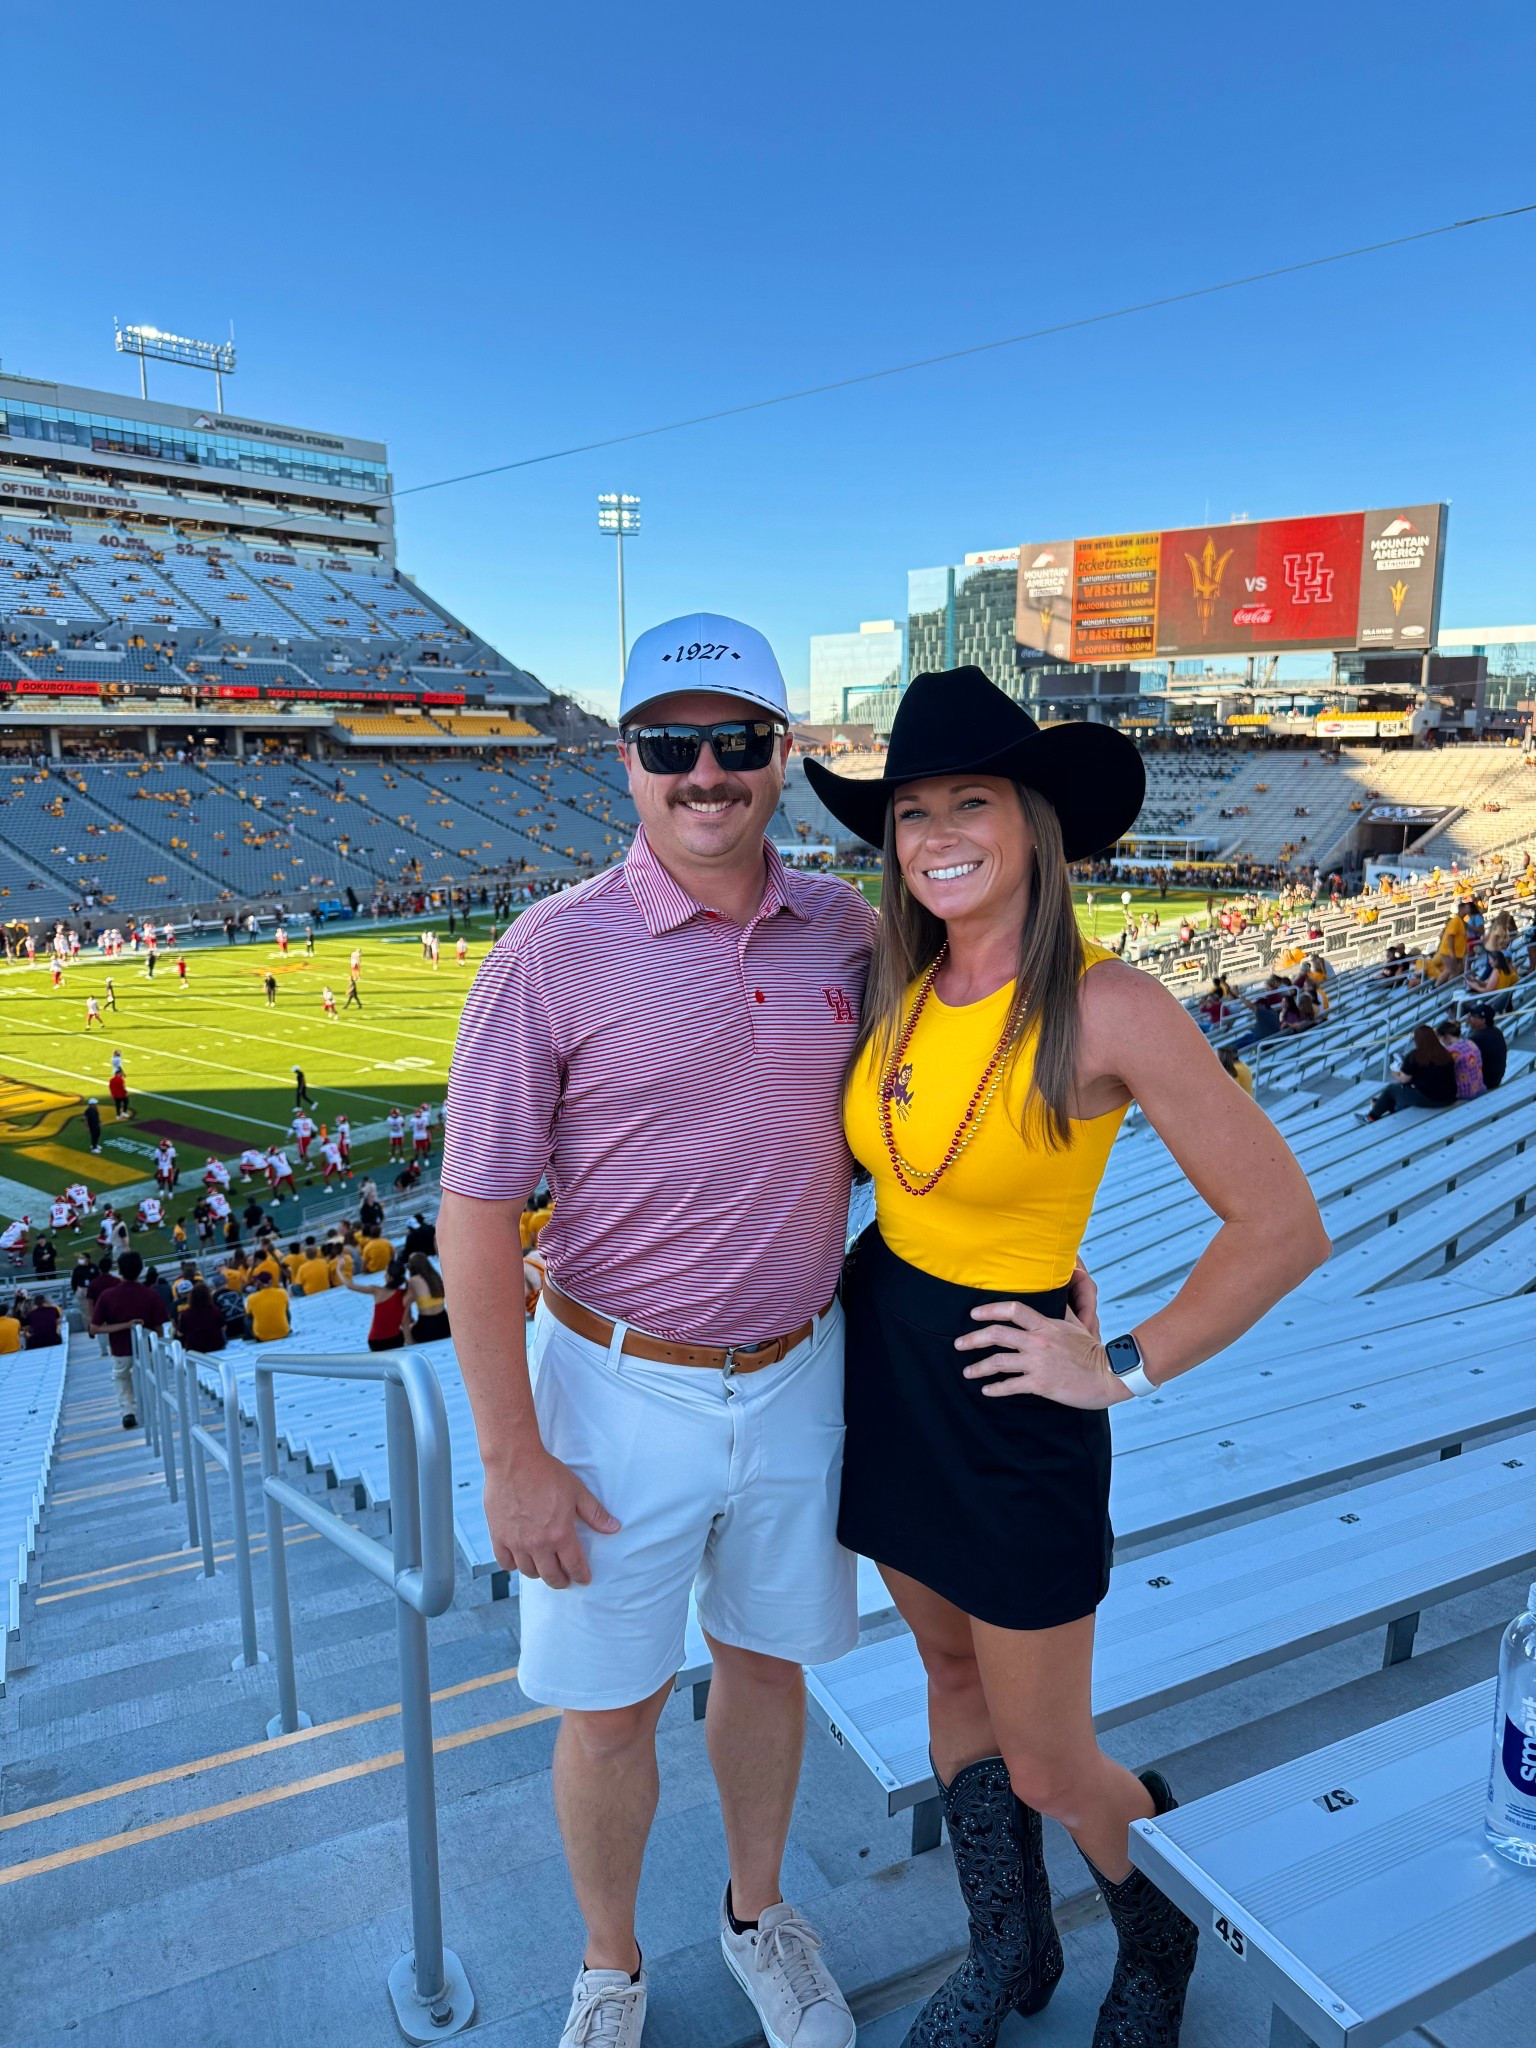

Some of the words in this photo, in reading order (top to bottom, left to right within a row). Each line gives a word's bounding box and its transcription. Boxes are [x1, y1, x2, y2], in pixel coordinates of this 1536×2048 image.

[215, 419, 264, 436] MOUNTAIN
[265, 428, 304, 443] AMERICA
[306, 435, 344, 450] STADIUM
[2, 482, 19, 494] OF
[21, 485, 45, 498] THE
[47, 488, 71, 500] ASU
[73, 491, 97, 503] SUN
[98, 495, 138, 509] DEVILS
[98, 534, 119, 547] 40
[1371, 535, 1430, 551] MOUNTAIN
[176, 543, 194, 556] 52
[1373, 547, 1425, 560] AMERICA
[254, 551, 271, 563] 62
[317, 559, 325, 569] 7
[1078, 556, 1153, 572] ticketmaster
[1024, 567, 1069, 580] MOUNTAIN
[1026, 578, 1066, 589] AMERICA
[1083, 581, 1150, 598] WRESTLING
[1245, 576, 1268, 592] VS
[1077, 630, 1088, 641] W
[1088, 626, 1152, 641] BASKETBALL
[675, 643, 730, 663] 1927
[1084, 643, 1110, 654] COPPIN
[22, 683, 97, 692] GOKUBOTA.com
[1502, 1459, 1524, 1469] 34
[1338, 1512, 1361, 1524] 35
[1147, 1575, 1172, 1589] 36
[830, 1723, 842, 1746] 44
[1324, 1789, 1354, 1812] 37
[1215, 1917, 1245, 1958] 45
